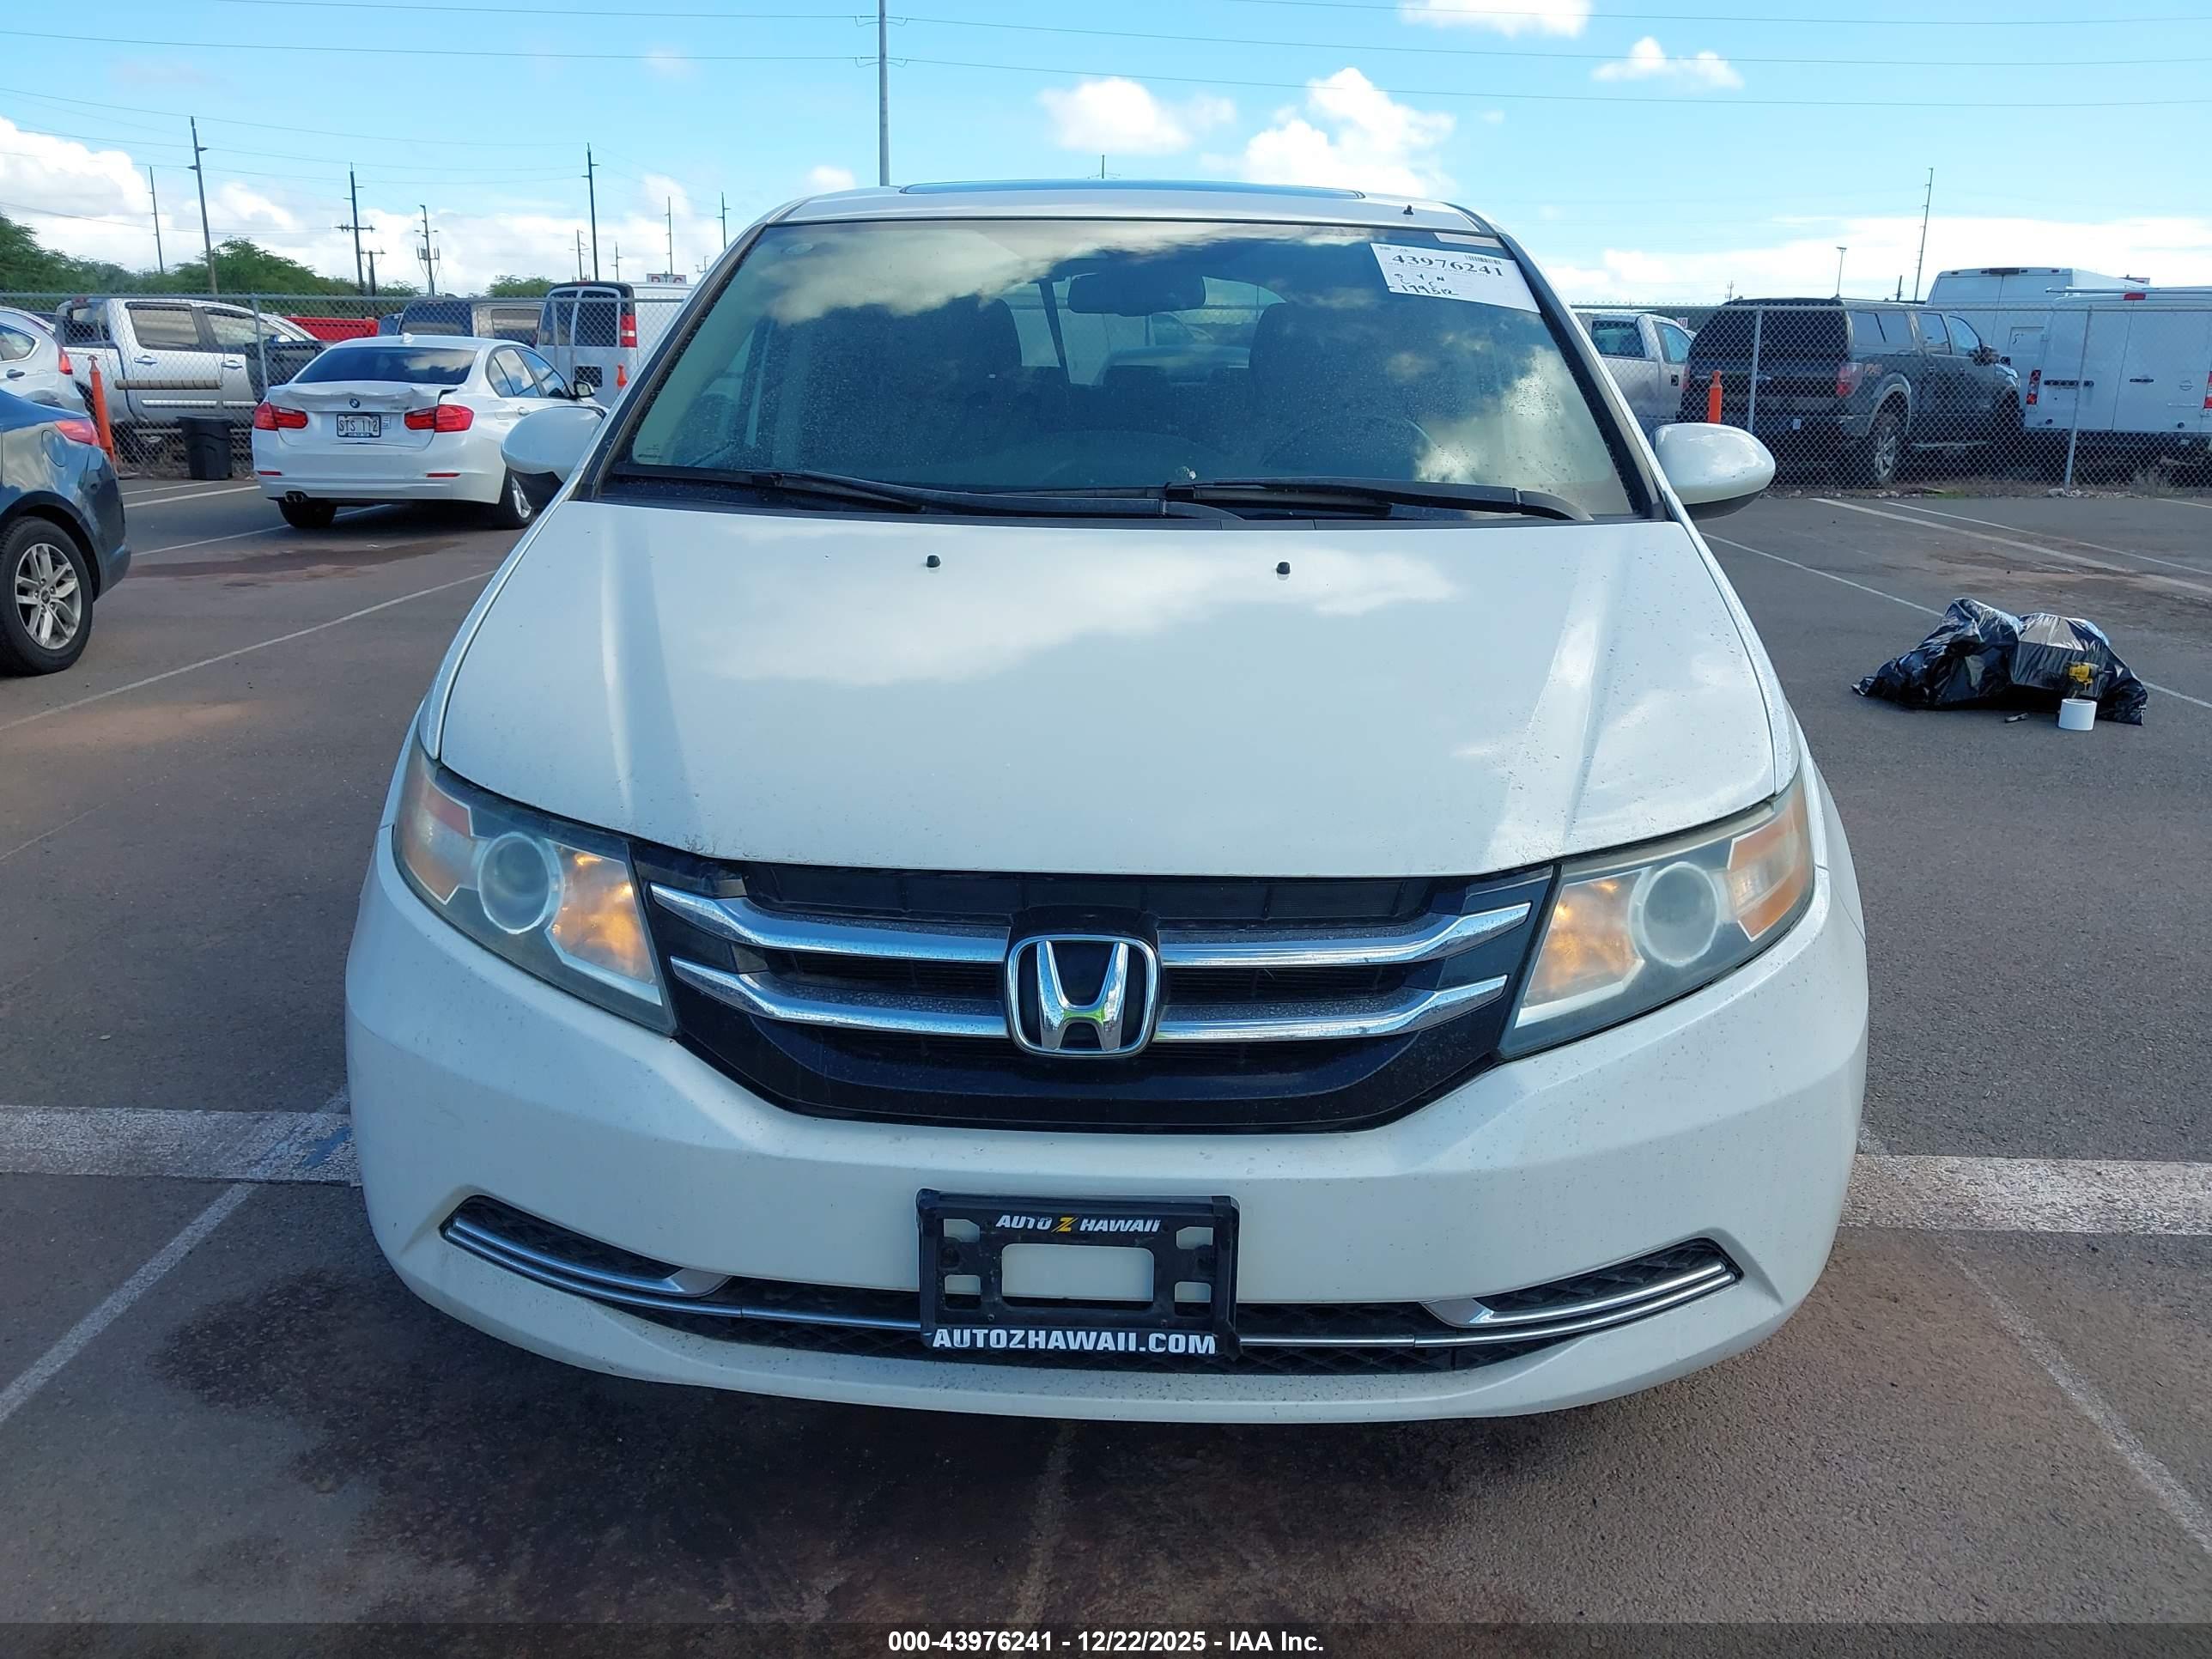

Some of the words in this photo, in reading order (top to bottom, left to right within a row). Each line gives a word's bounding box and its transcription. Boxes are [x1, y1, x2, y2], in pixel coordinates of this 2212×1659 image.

[1392, 254, 1504, 276] 43976241
[338, 420, 356, 432] STS
[362, 420, 378, 432] 112
[996, 1215, 1052, 1230] AUTO
[1051, 1217, 1079, 1233] Z
[1079, 1218, 1161, 1232] HAWAII
[933, 1328, 1216, 1354] AUTOZHAWAII.COM
